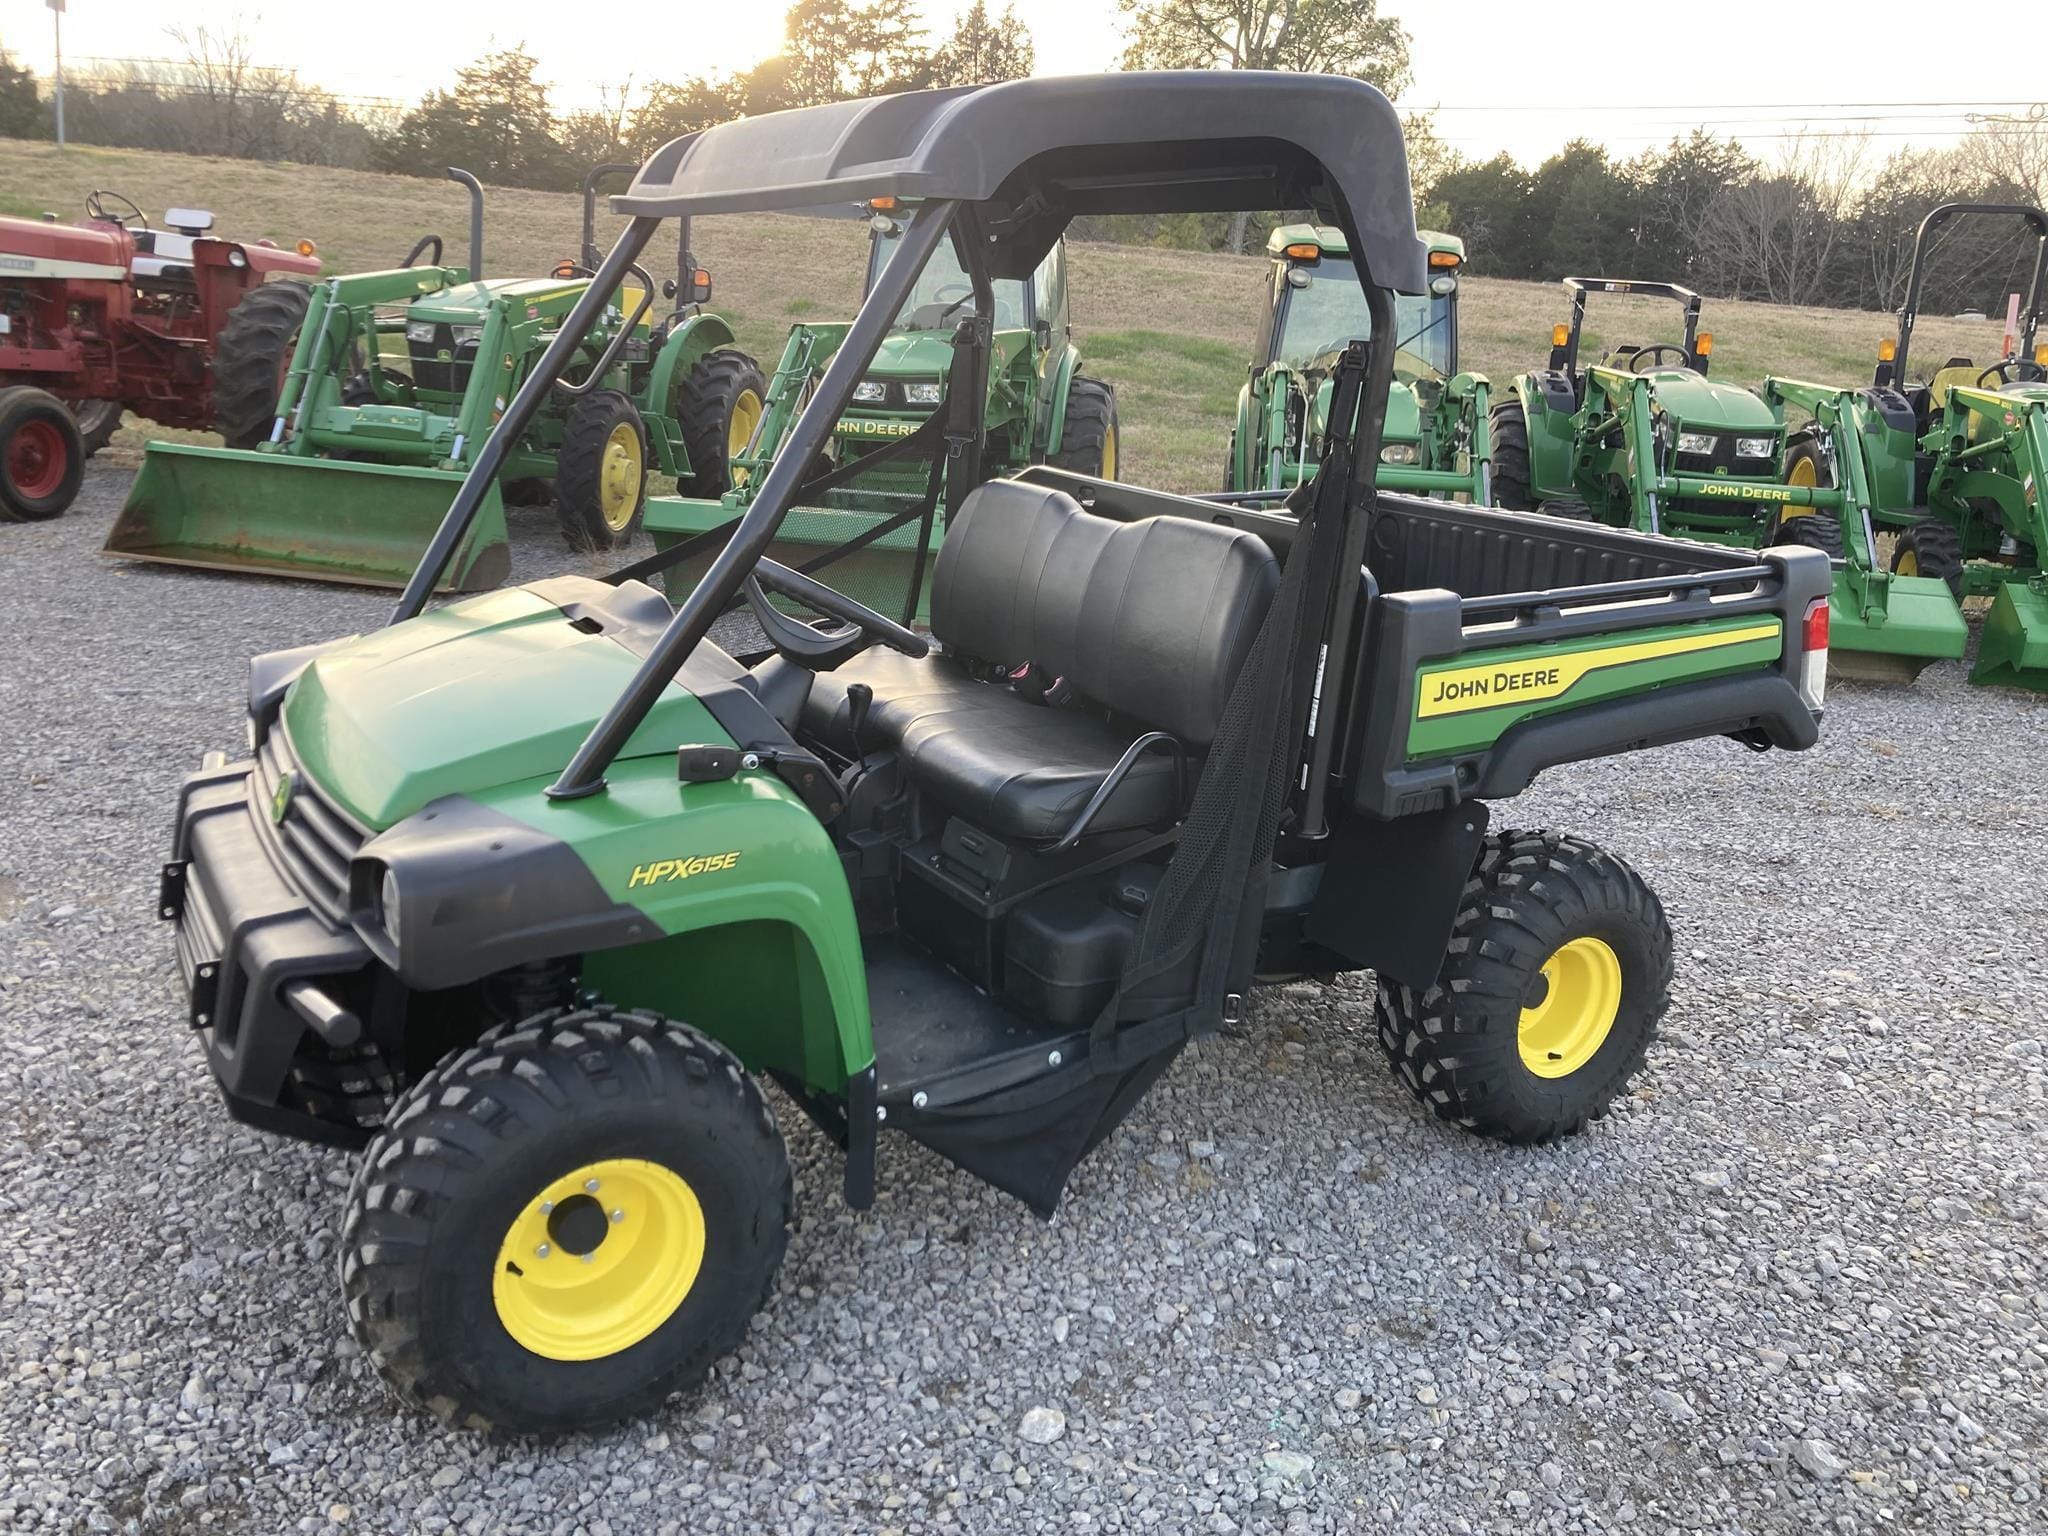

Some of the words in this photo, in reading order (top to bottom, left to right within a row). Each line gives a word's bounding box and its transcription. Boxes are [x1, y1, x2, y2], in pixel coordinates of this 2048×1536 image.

[1698, 483, 1739, 497] JOHN
[1742, 486, 1791, 501] DEERE
[1433, 678, 1489, 702] JOHN
[1493, 668, 1559, 693] DEERE
[627, 851, 741, 888] HPX615E
